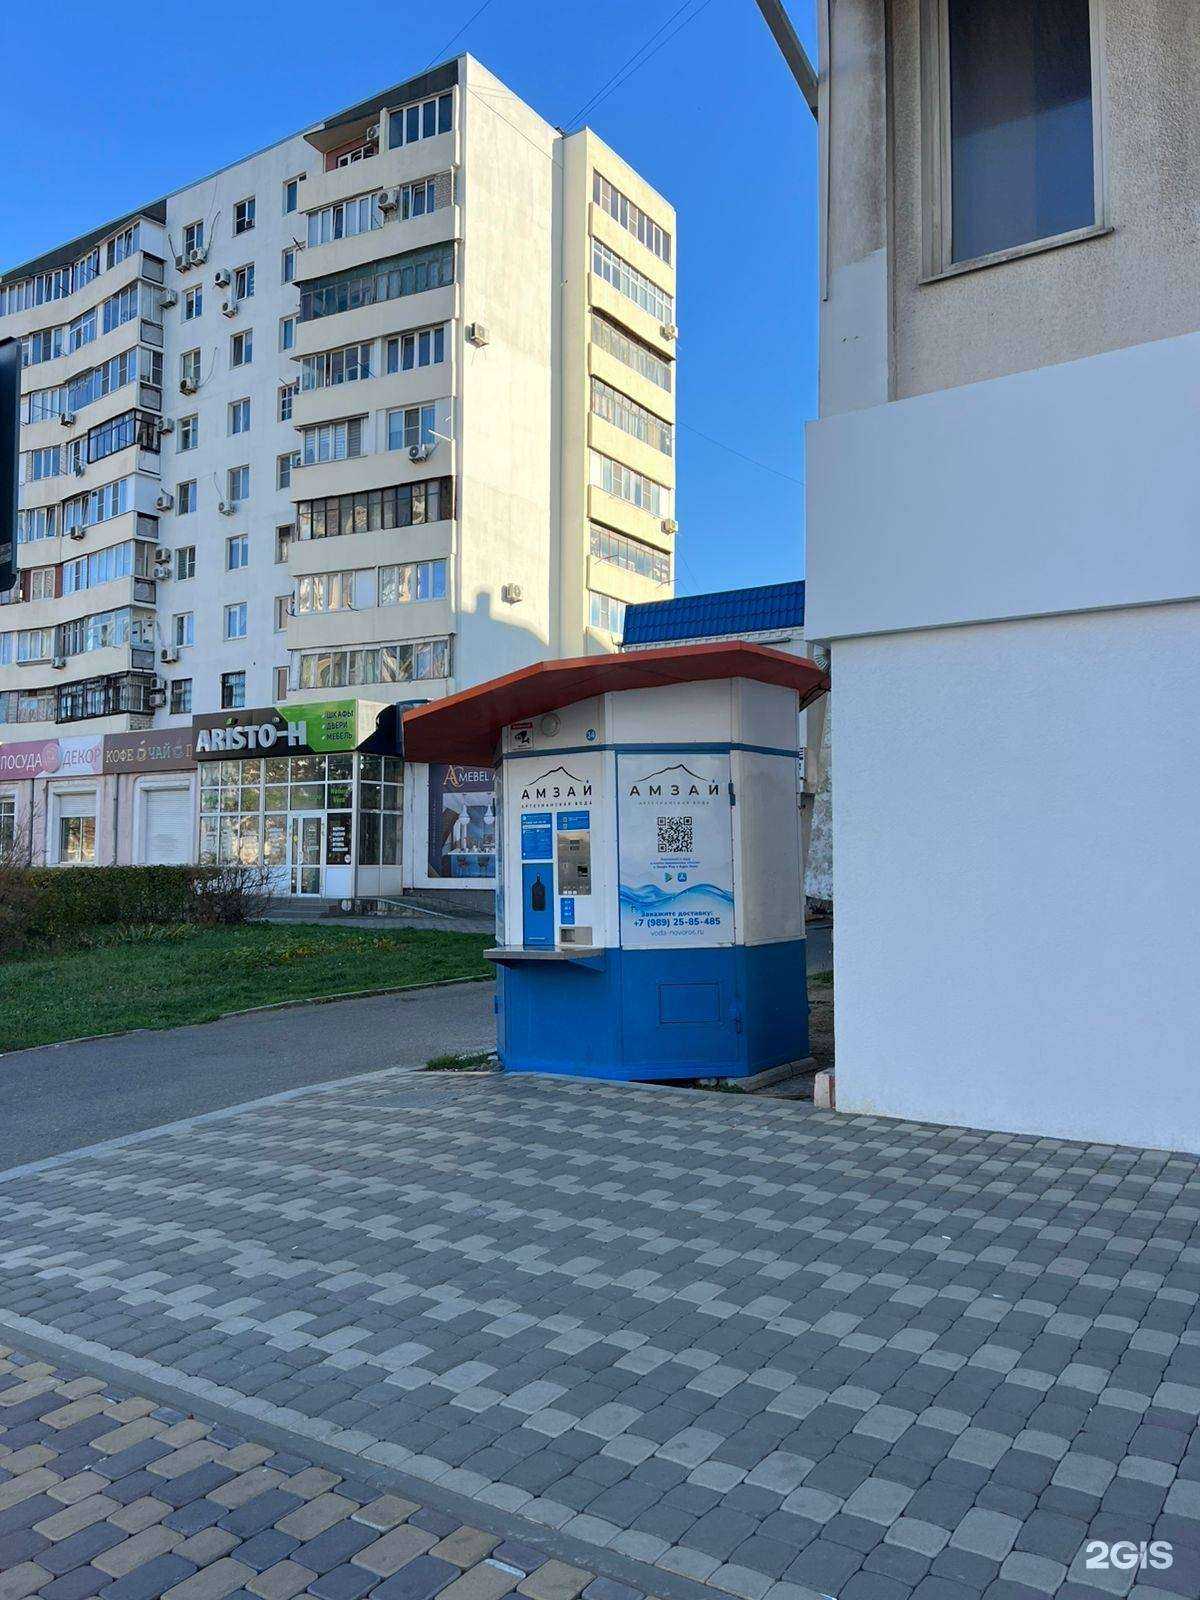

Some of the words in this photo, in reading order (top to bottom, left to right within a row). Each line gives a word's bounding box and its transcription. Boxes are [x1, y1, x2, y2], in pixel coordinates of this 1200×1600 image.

[1, 753, 43, 772] ПОСУДА
[105, 748, 134, 763] КОФЕ
[521, 780, 592, 800] АМЗАЙ
[629, 780, 719, 797] АМЗАЙ
[634, 918, 644, 927] +7
[647, 918, 670, 927] (989)
